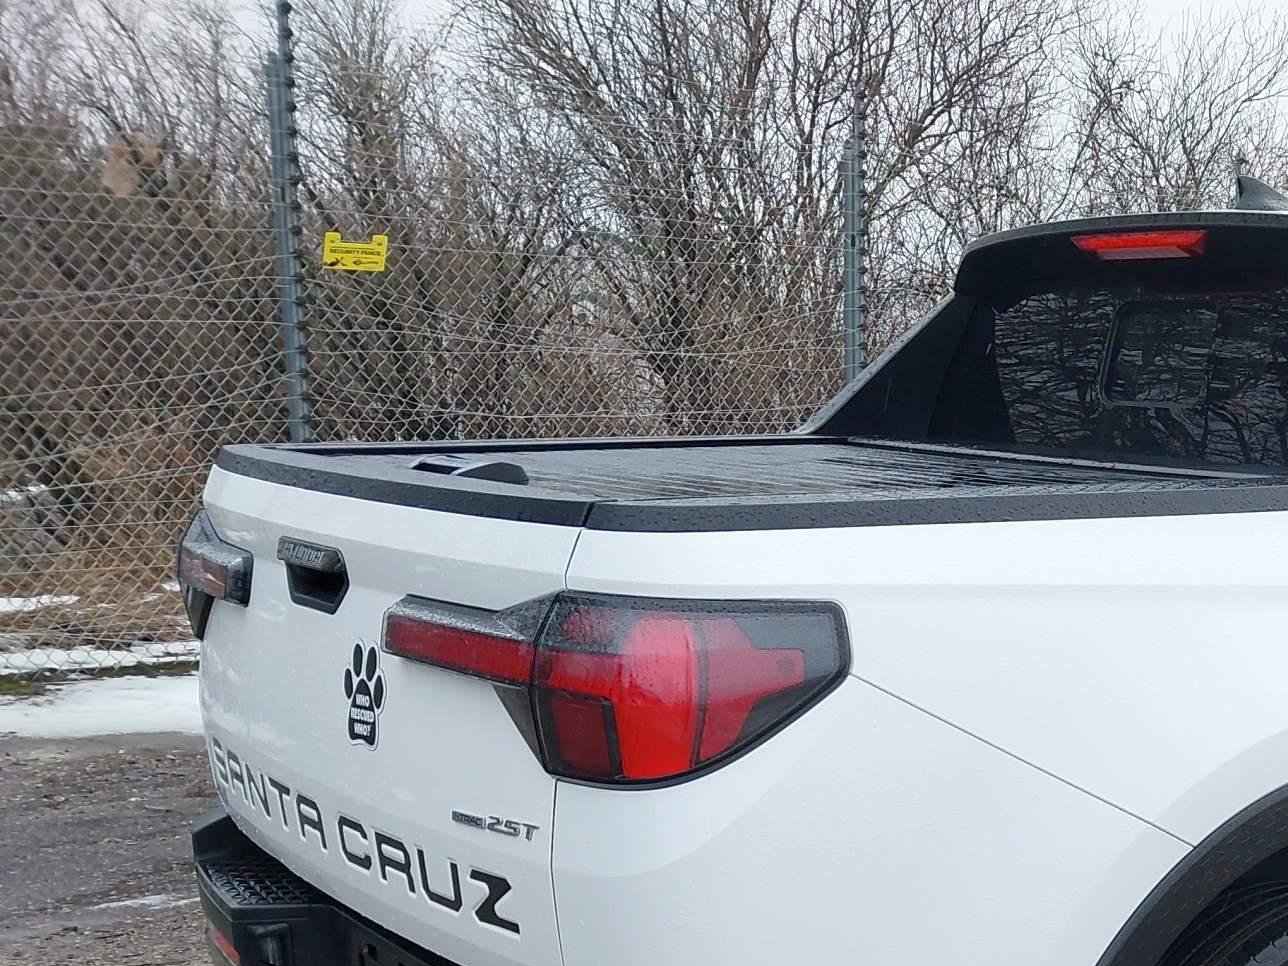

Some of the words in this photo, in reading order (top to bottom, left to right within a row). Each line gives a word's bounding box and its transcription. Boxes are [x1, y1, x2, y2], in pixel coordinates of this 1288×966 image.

[355, 693, 370, 708] WHO
[350, 706, 375, 723] RESCUED
[353, 721, 372, 737] WHO?
[212, 737, 328, 851] SANTA
[337, 815, 521, 935] CRUZ
